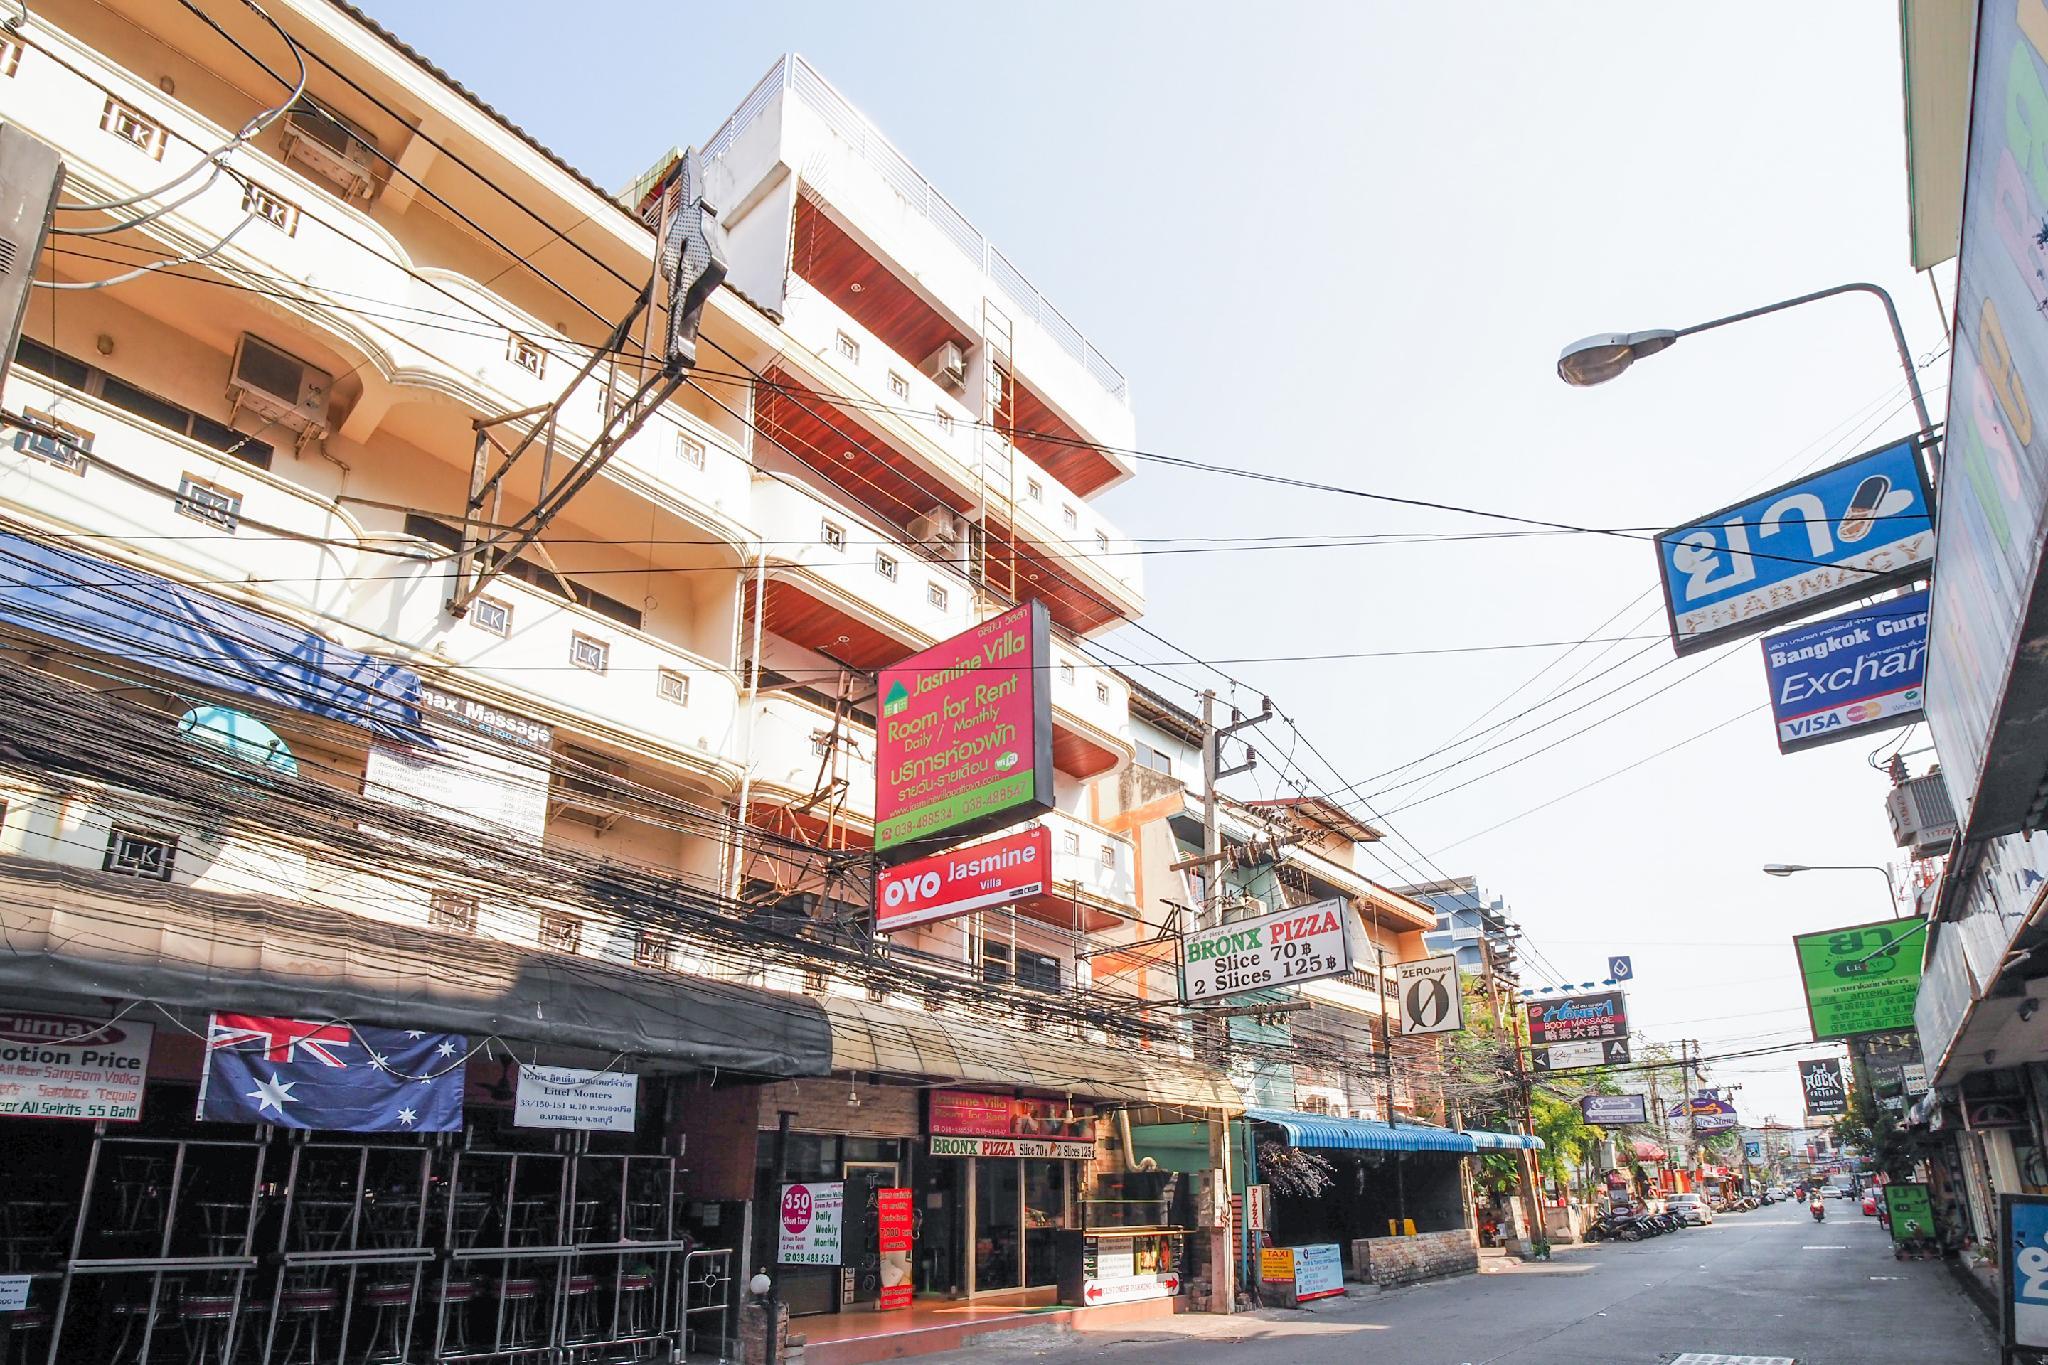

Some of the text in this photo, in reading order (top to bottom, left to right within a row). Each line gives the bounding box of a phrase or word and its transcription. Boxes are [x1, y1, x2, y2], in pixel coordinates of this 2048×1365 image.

[1672, 492, 1835, 602] ยา
[1685, 534, 1924, 635] PHARMACY
[1770, 627, 1871, 670] Bangkok
[913, 629, 1026, 697] Jasmine Villa
[887, 673, 1019, 744] Room for Rent
[464, 700, 552, 743] Massage
[904, 732, 932, 753] Daily
[953, 703, 1001, 734] Monthly
[1786, 713, 1842, 737] VISA
[891, 723, 1016, 786] บริการห้องพัก
[883, 845, 1037, 907] OYO Jasmine
[979, 877, 1003, 891] Villa
[1187, 911, 1341, 963] BRONX PIZZA
[1214, 953, 1260, 974] Slice
[1271, 942, 1297, 961] 70
[1194, 979, 1206, 996] 2
[1215, 969, 1272, 991] Slices
[1283, 954, 1323, 978] 125
[1401, 966, 1431, 979] ZERO
[1544, 1015, 1615, 1030] BODY MASSAGE
[0, 1046, 141, 1070] otion Price
[44, 1065, 101, 1084] Sangsom
[104, 1070, 140, 1086] Vodka
[1803, 1070, 1843, 1093] ROCK
[20, 1101, 38, 1114] All
[41, 1102, 82, 1116] Spirits
[110, 1105, 136, 1118] Bath
[932, 1138, 979, 1156] BRONX
[981, 1140, 1016, 1156] PIZZA
[1019, 1143, 1035, 1157] Slice
[1035, 1144, 1045, 1157] 70
[1056, 1146, 1062, 1157] 2
[1063, 1145, 1081, 1158] Slices
[1080, 1146, 1092, 1158] 125
[785, 1193, 810, 1210] 350
[784, 1216, 809, 1225] Short Time
[815, 1211, 832, 1222] Daily
[815, 1223, 838, 1236] Weekly
[814, 1237, 839, 1249] Monthly
[1267, 1250, 1289, 1258] TAXI
